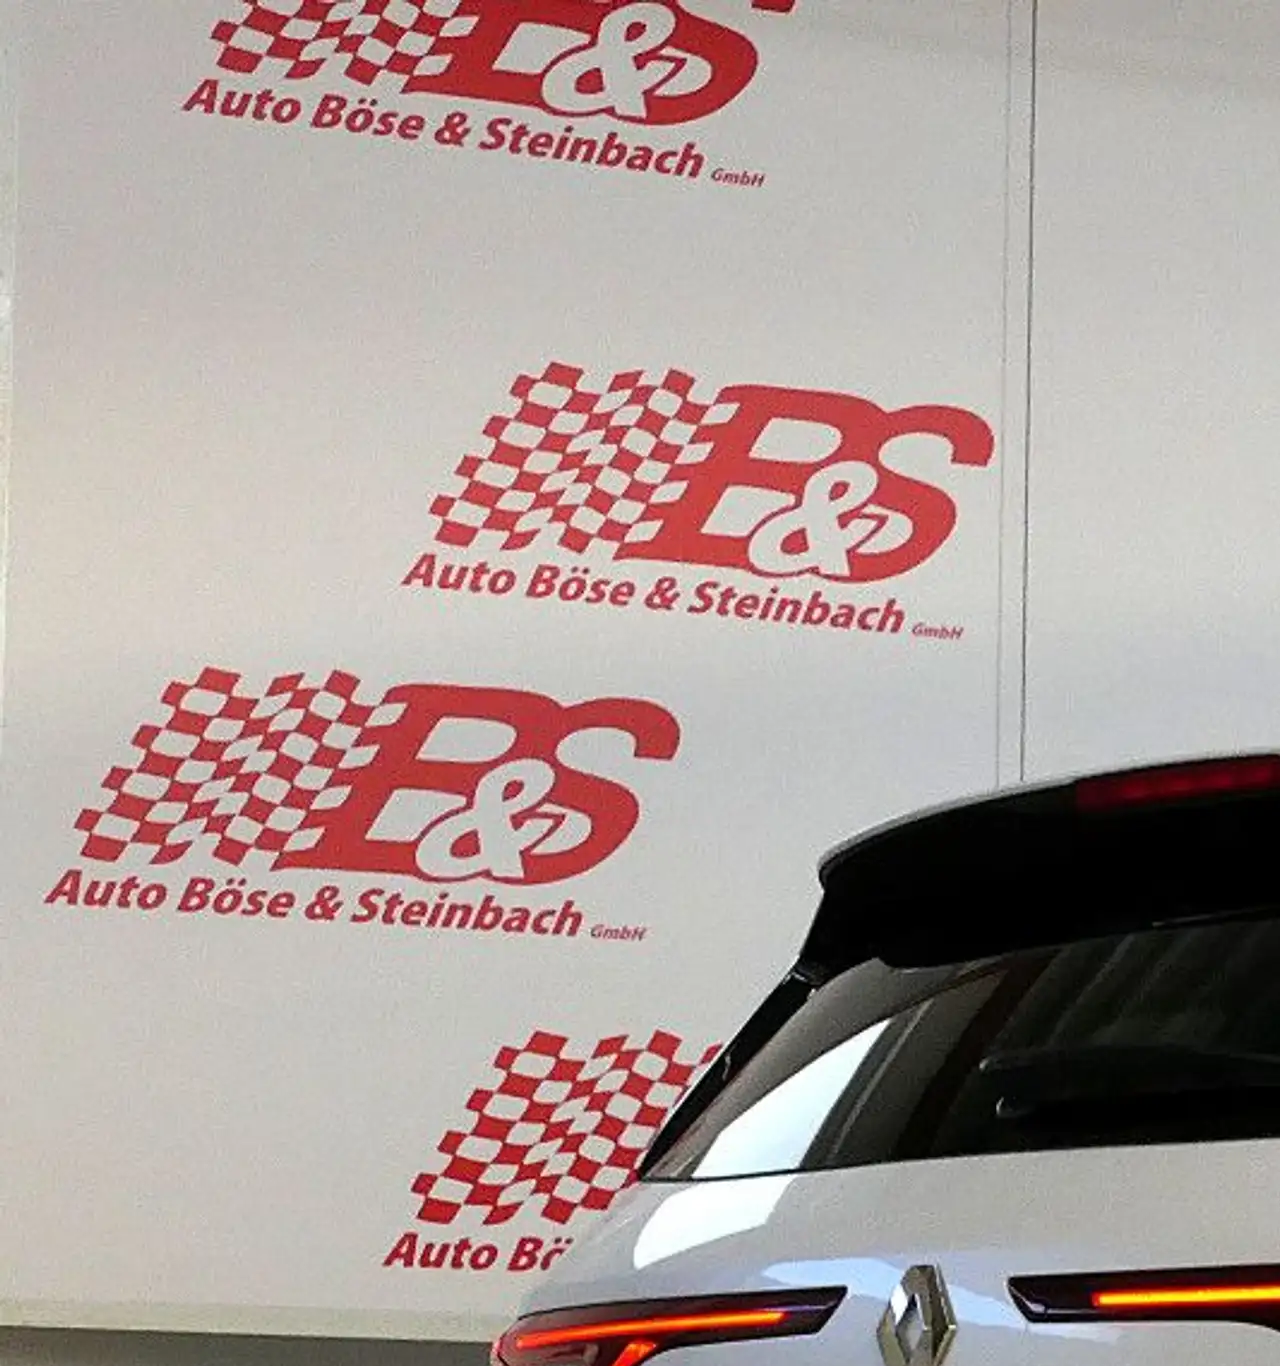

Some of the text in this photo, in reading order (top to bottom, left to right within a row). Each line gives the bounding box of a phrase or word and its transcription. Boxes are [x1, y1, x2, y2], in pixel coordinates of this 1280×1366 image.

[180, 79, 765, 188] Auto Böse & Steinbach GmbH
[400, 553, 964, 641] Auto Böse & Steinbach GmbH
[46, 870, 648, 942] Auto Böse & Steinbach GmbH
[382, 1232, 498, 1270] Auto
